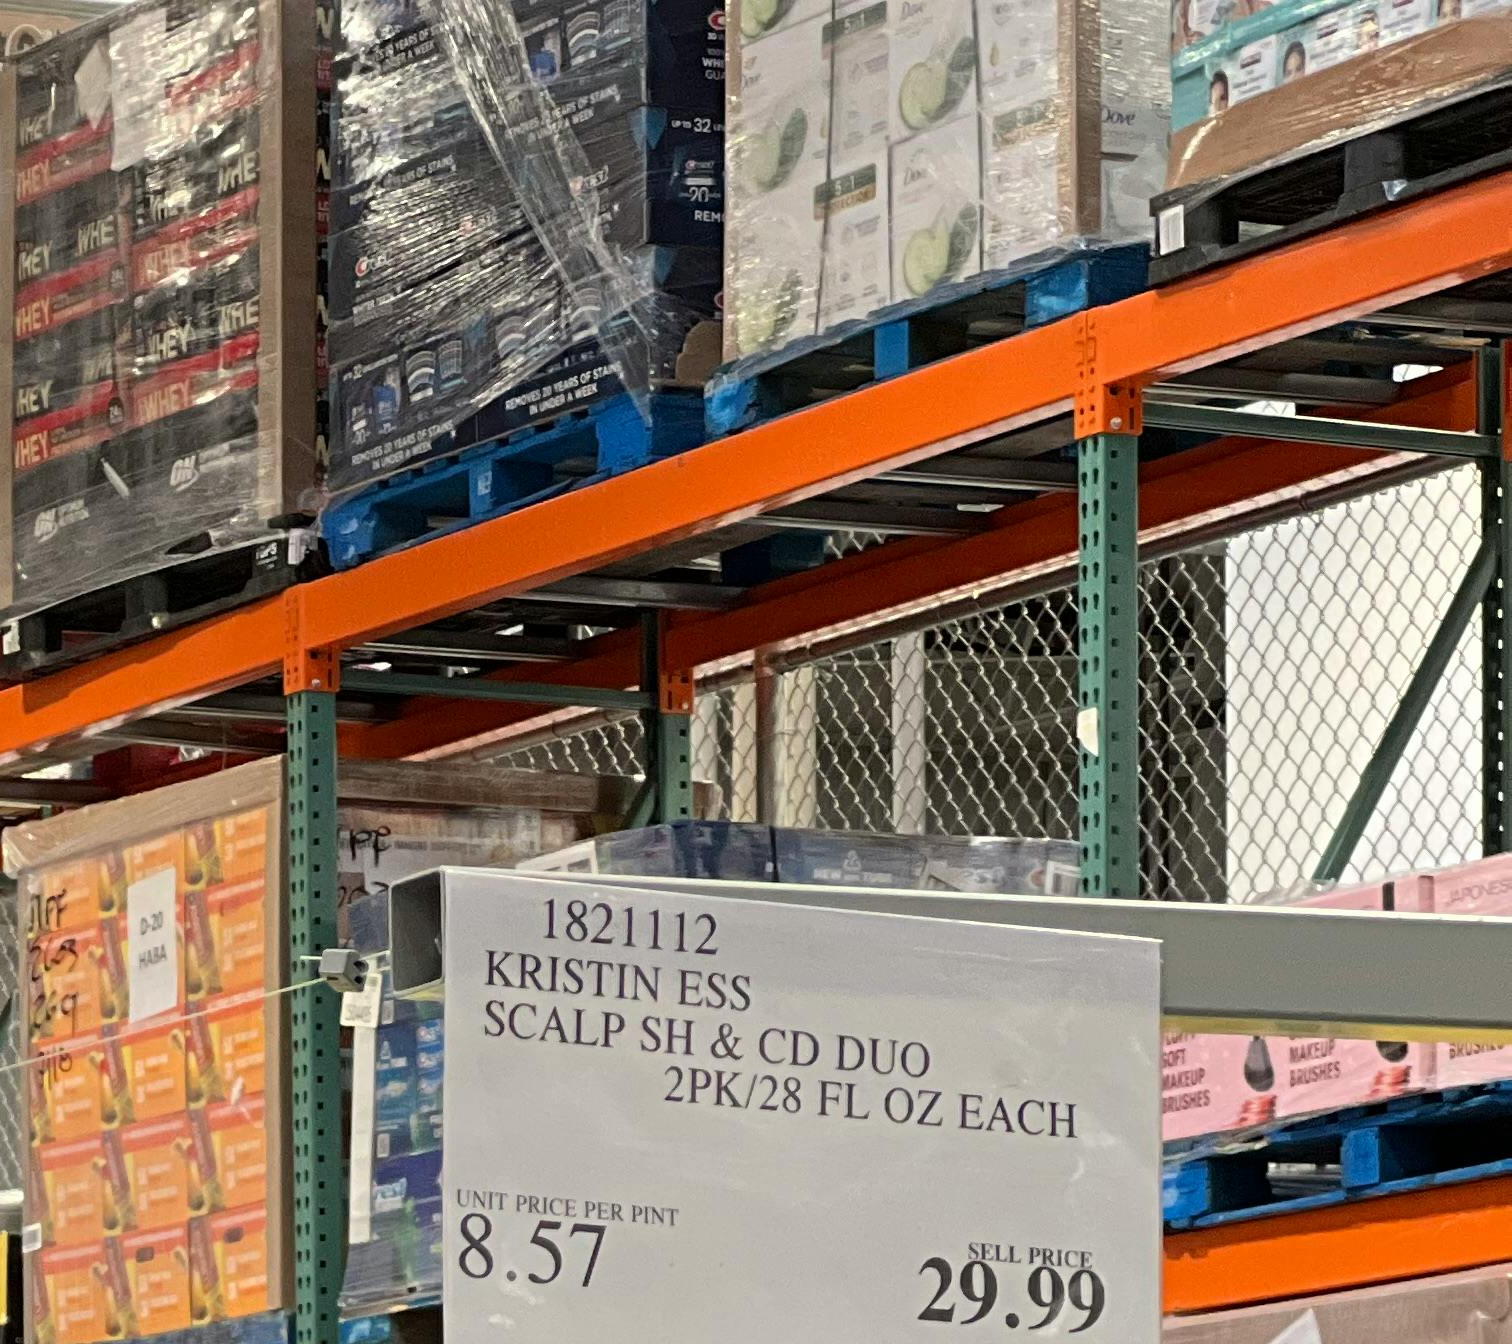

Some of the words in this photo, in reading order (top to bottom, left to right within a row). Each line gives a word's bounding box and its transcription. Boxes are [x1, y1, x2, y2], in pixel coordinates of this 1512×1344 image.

[540, 394, 564, 412] UNDER
[575, 383, 598, 400] WEEK
[554, 376, 578, 394] YEARS
[542, 898, 717, 954] 1821112
[486, 950, 659, 1001] KRISTIN
[679, 971, 750, 1011] ESS
[484, 1000, 626, 1050] SCALP
[640, 1016, 694, 1058] SH
[710, 1023, 742, 1061] &
[759, 1028, 819, 1069] CD
[837, 1034, 930, 1078] DUO
[1290, 1040, 1335, 1059] MAKEUP
[1290, 1061, 1340, 1087] BRUSHES
[664, 1066, 802, 1114] 2PK/28
[819, 1081, 869, 1121] FL
[884, 1087, 942, 1128] OZ
[959, 1095, 1077, 1139] EACH
[456, 1189, 507, 1211] UNIT
[515, 1193, 577, 1219] PRICE
[584, 1199, 624, 1222] PER
[630, 1202, 679, 1226] PINT
[457, 1214, 606, 1288] 8.57
[968, 1241, 1021, 1265] SELL
[1027, 1245, 1093, 1269] PRICE
[917, 1256, 1105, 1333] 29.99
